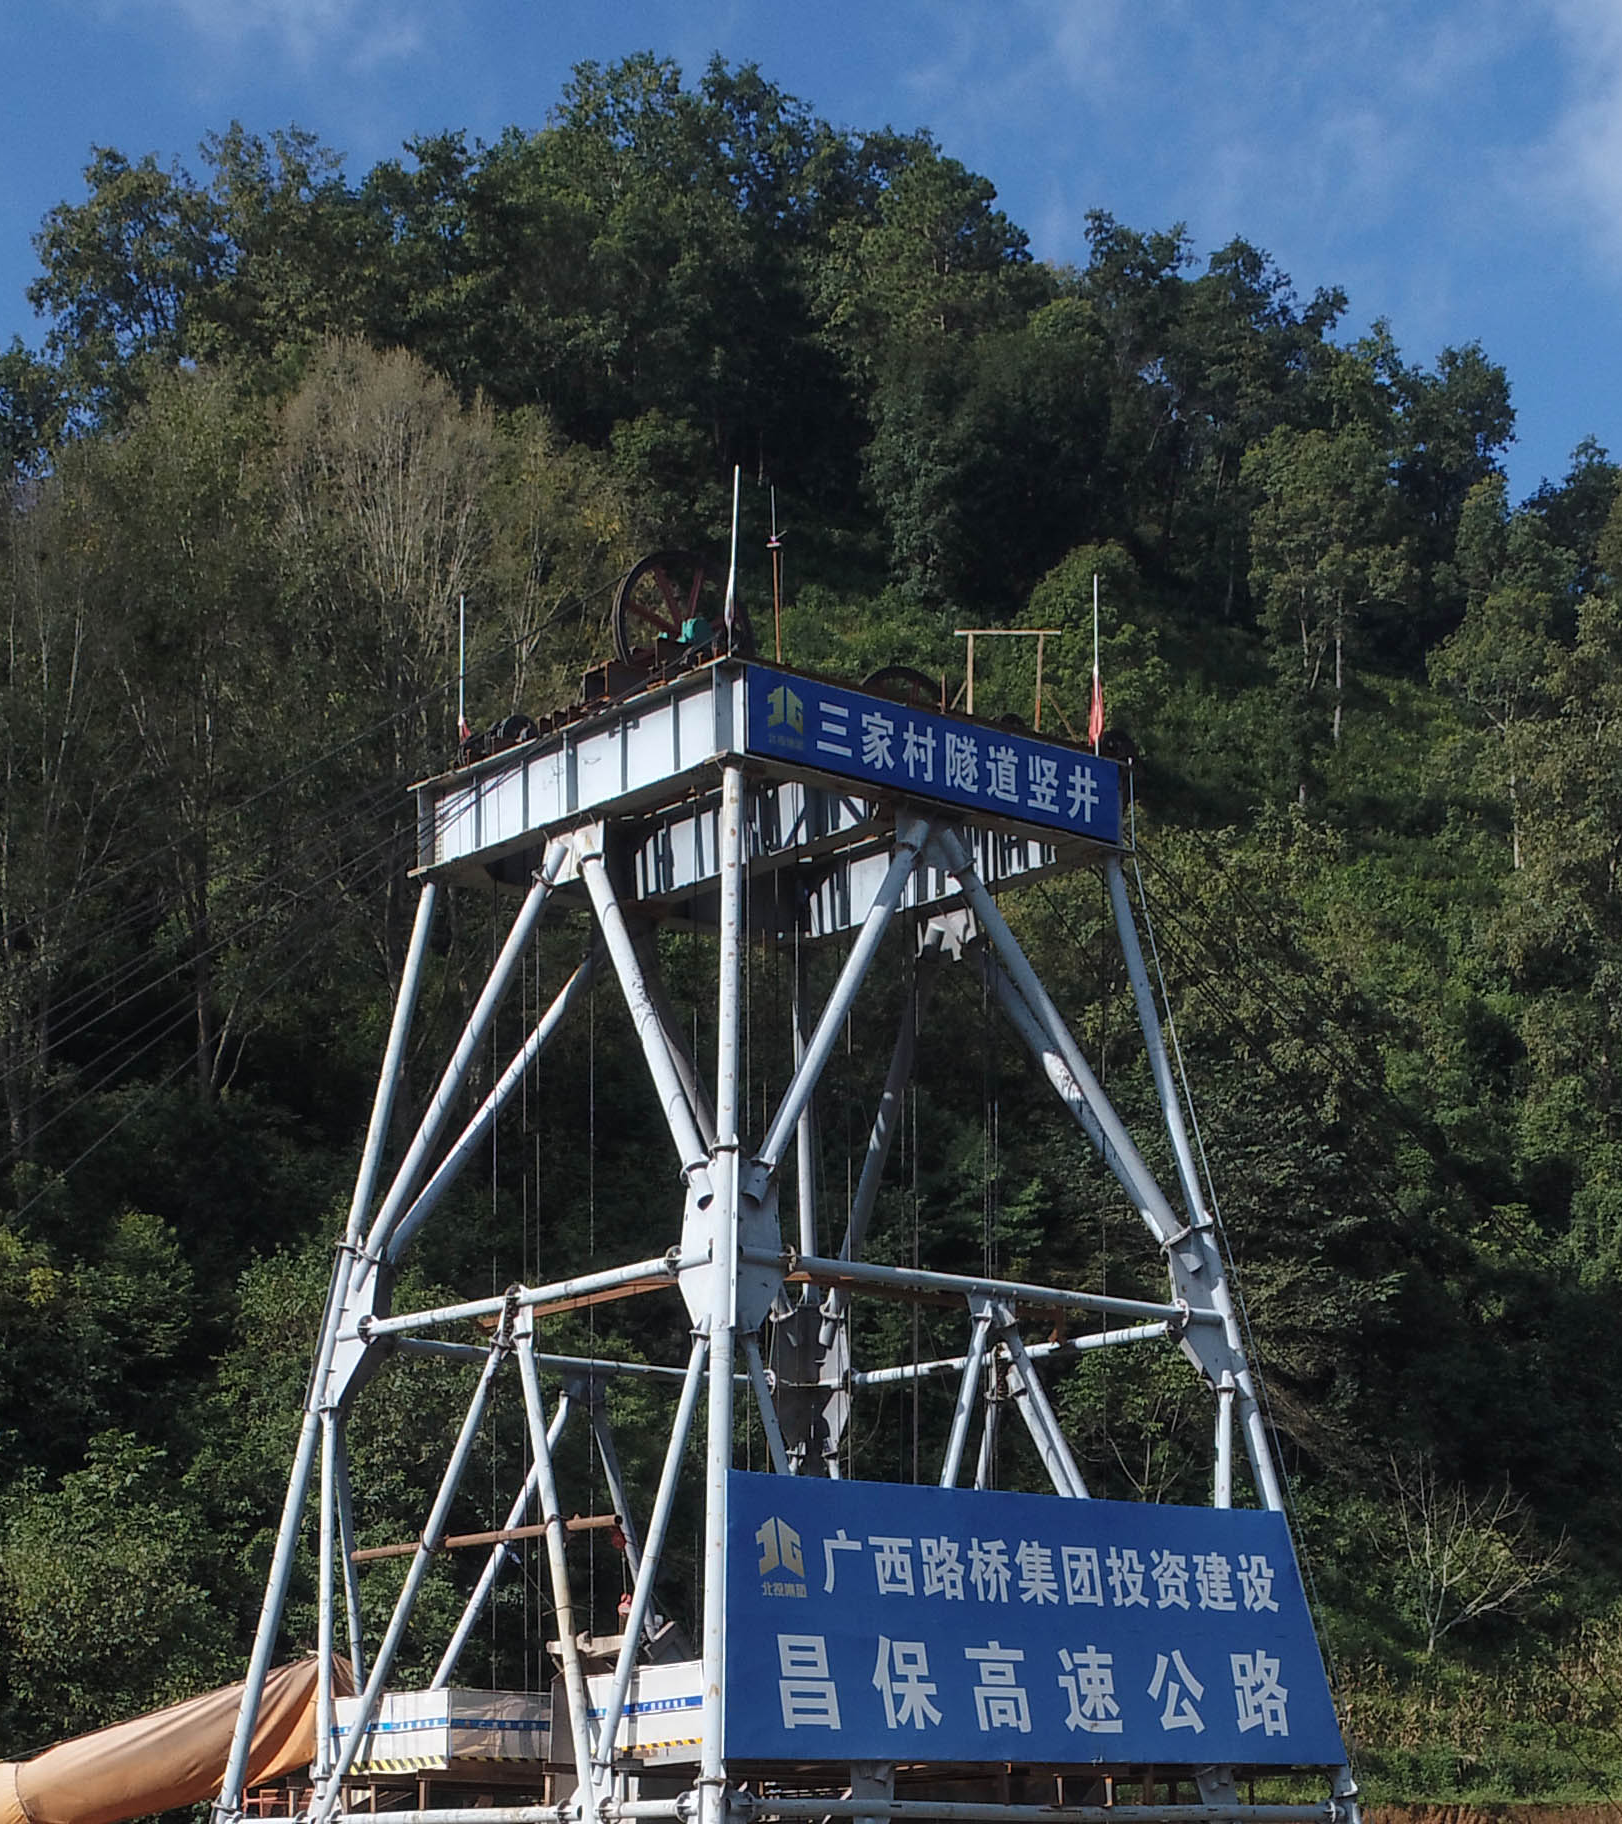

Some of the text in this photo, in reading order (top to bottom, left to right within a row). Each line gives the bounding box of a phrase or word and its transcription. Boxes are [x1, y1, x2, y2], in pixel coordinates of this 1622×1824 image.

[816, 701, 1099, 824] 三家村隧道竖井
[823, 1528, 1279, 1613] 广西路桥集团投资建设
[777, 1634, 1289, 1736] 昌保高速公路
